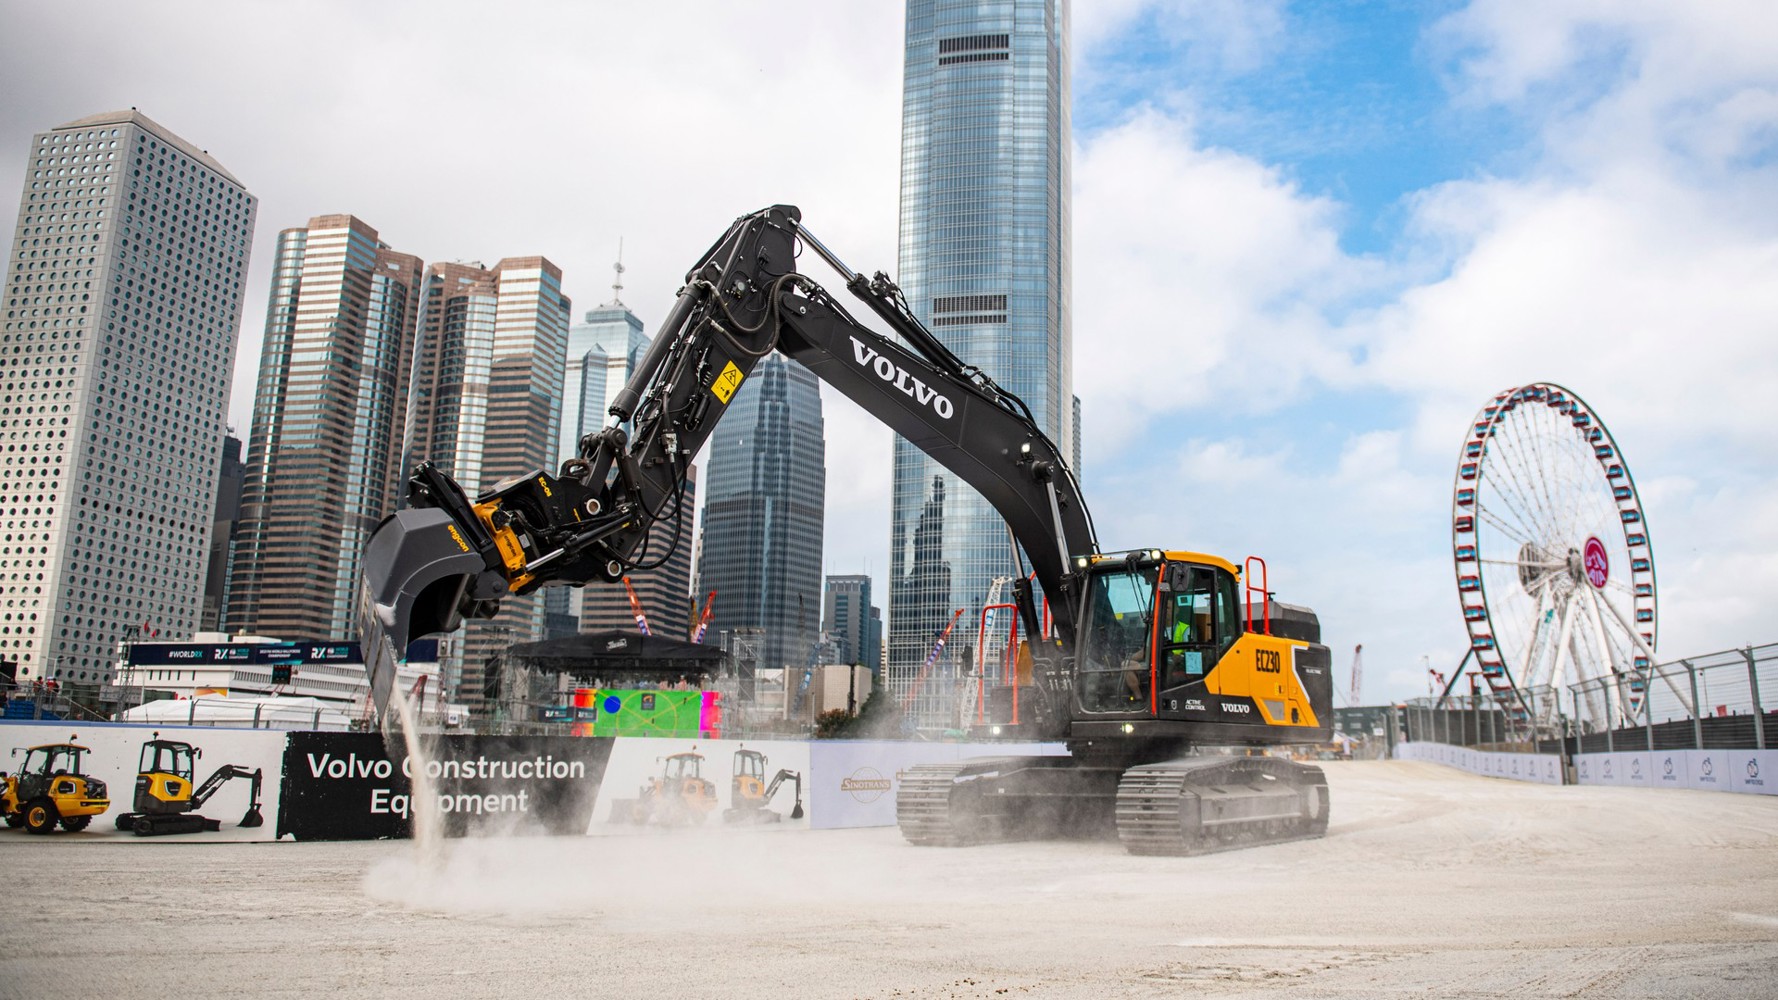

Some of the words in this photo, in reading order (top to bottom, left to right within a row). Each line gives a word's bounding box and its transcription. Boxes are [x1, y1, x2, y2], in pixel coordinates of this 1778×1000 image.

[849, 335, 954, 419] VOLVO
[447, 524, 470, 552] engcon
[168, 650, 203, 659] #WORLDRX
[1255, 649, 1280, 674] EC230
[1221, 702, 1250, 714] VOLVO
[307, 753, 392, 779] Volvo
[370, 789, 528, 819] Eqpment
